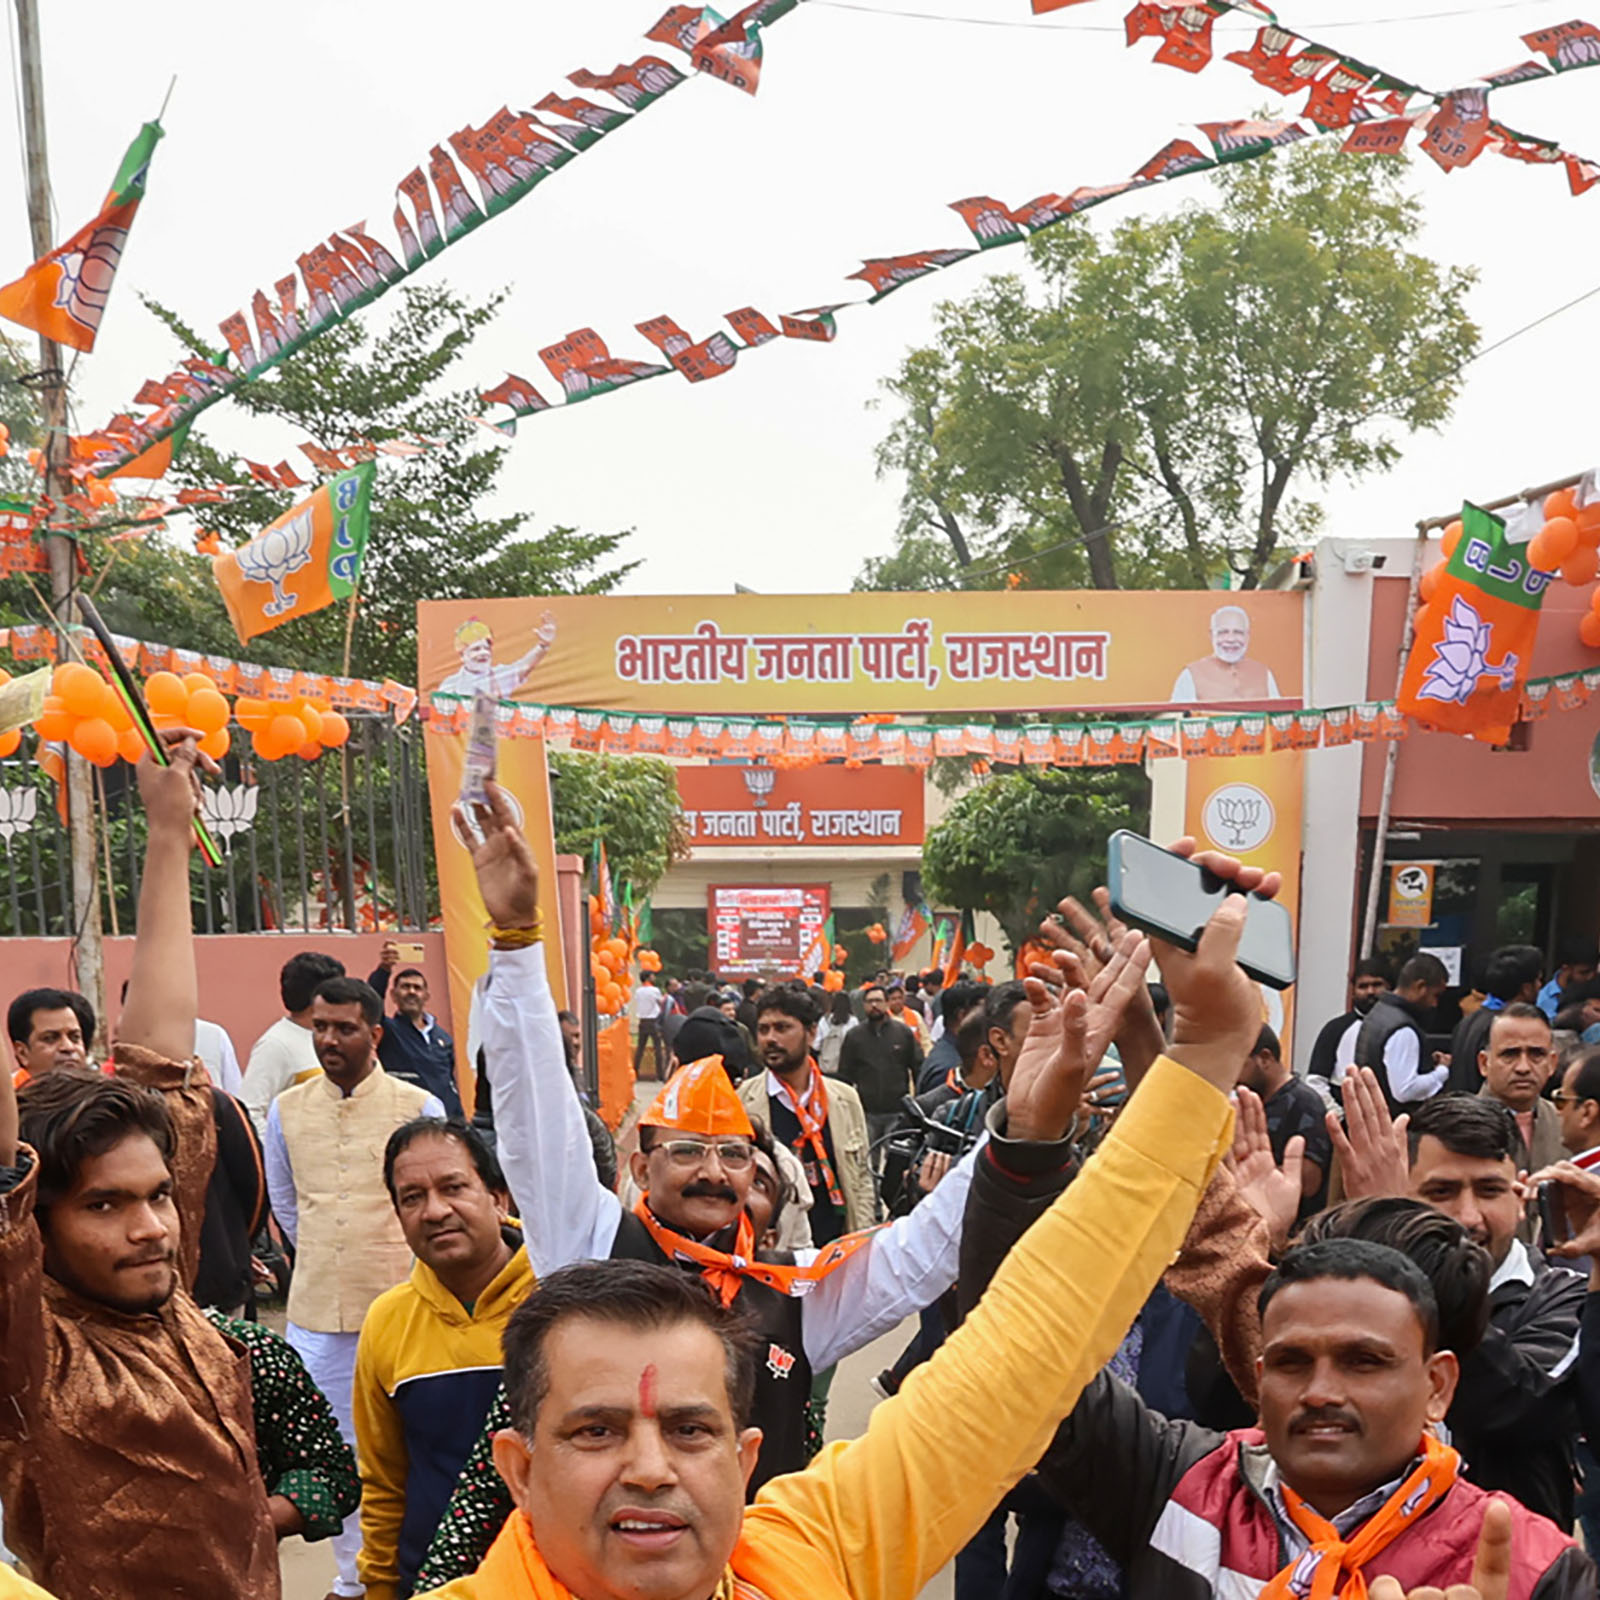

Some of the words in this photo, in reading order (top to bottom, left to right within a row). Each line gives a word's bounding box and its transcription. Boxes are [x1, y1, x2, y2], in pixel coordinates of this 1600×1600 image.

[1354, 133, 1398, 148] BJP
[1430, 126, 1468, 157] BJP
[616, 623, 748, 681] भारतीय
[752, 636, 853, 680] जनता
[859, 620, 939, 687] पार्टी,
[945, 634, 1109, 680] राजस्थान
[702, 811, 756, 837] जनता
[761, 802, 805, 841] पार्टी,
[810, 810, 901, 837] राजस्थान
